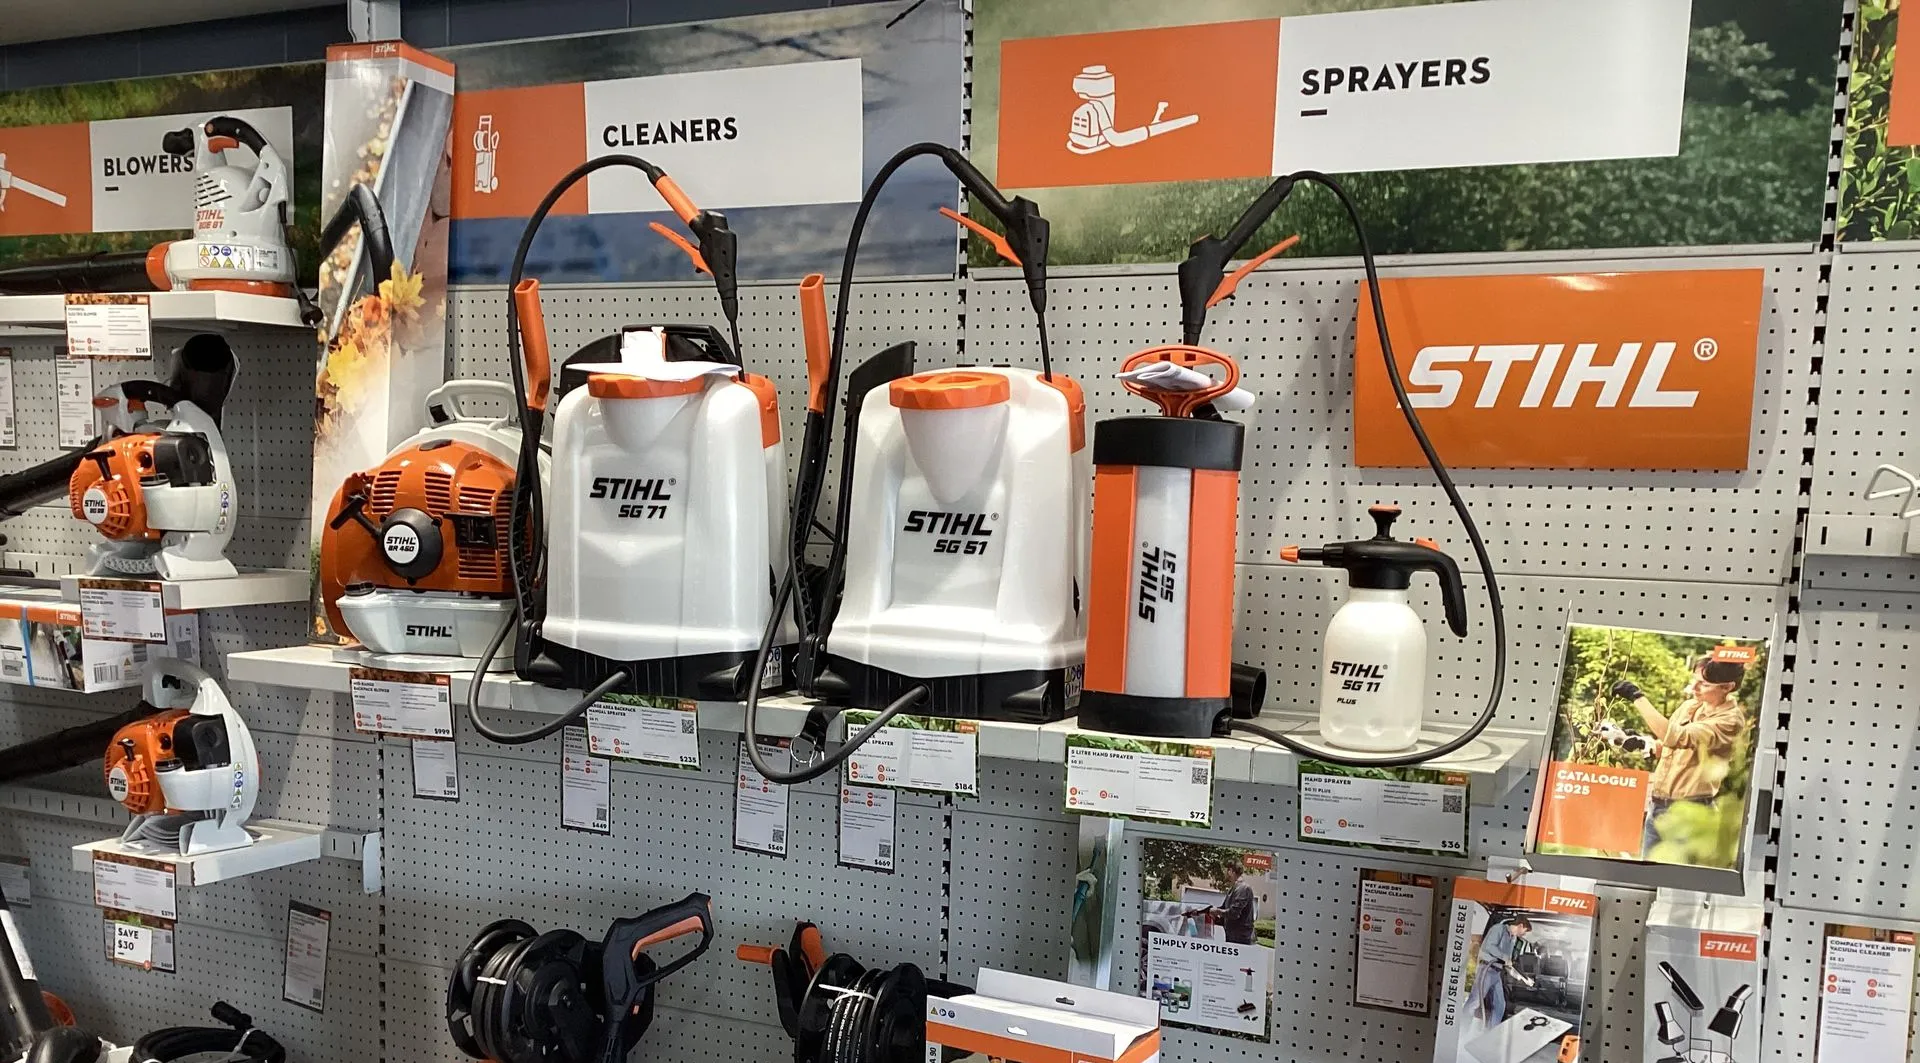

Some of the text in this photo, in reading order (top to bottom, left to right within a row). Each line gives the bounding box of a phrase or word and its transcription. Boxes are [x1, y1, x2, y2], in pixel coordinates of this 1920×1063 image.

[1301, 57, 1490, 95] SPRAYERS
[603, 117, 737, 147] CLEANERS
[104, 154, 194, 176] BLOWERS
[196, 210, 224, 221] STIHL
[618, 504, 667, 519] SG 71
[386, 536, 416, 545] STIHL
[933, 539, 988, 555] SG 51
[1160, 550, 1176, 603] SG 31
[60, 613, 77, 621] STIHL
[406, 625, 452, 637] STIHL
[1717, 650, 1751, 659] STIHL
[1330, 661, 1384, 678] STIHL
[1342, 680, 1380, 692] SG 11
[1337, 697, 1357, 705] PLUS
[1556, 769, 1638, 788] CATALOGUE
[955, 782, 973, 791] $184
[1555, 782, 1591, 796] 2025
[1190, 811, 1206, 820] $72
[1441, 840, 1460, 849] $36
[874, 859, 890, 867] $669
[1246, 857, 1269, 866] STIHL
[1549, 895, 1588, 909] STIHL
[1457, 911, 1466, 921] 62
[117, 927, 139, 939] SAVE
[1456, 923, 1465, 934] SE
[117, 940, 134, 950] $30
[1153, 937, 1239, 956] SIMPLY SPOTLESS
[1454, 940, 1463, 951] 62
[1704, 940, 1752, 954] STIHL
[1830, 940, 1862, 948] COMPACT
[1452, 952, 1461, 963] SE
[1859, 949, 1891, 957] CLEANER
[1450, 975, 1458, 984] 61
[1448, 985, 1457, 997] SE
[1403, 1000, 1424, 1009] $379
[1447, 1004, 1455, 1013] 61
[1445, 1014, 1454, 1026] SE
